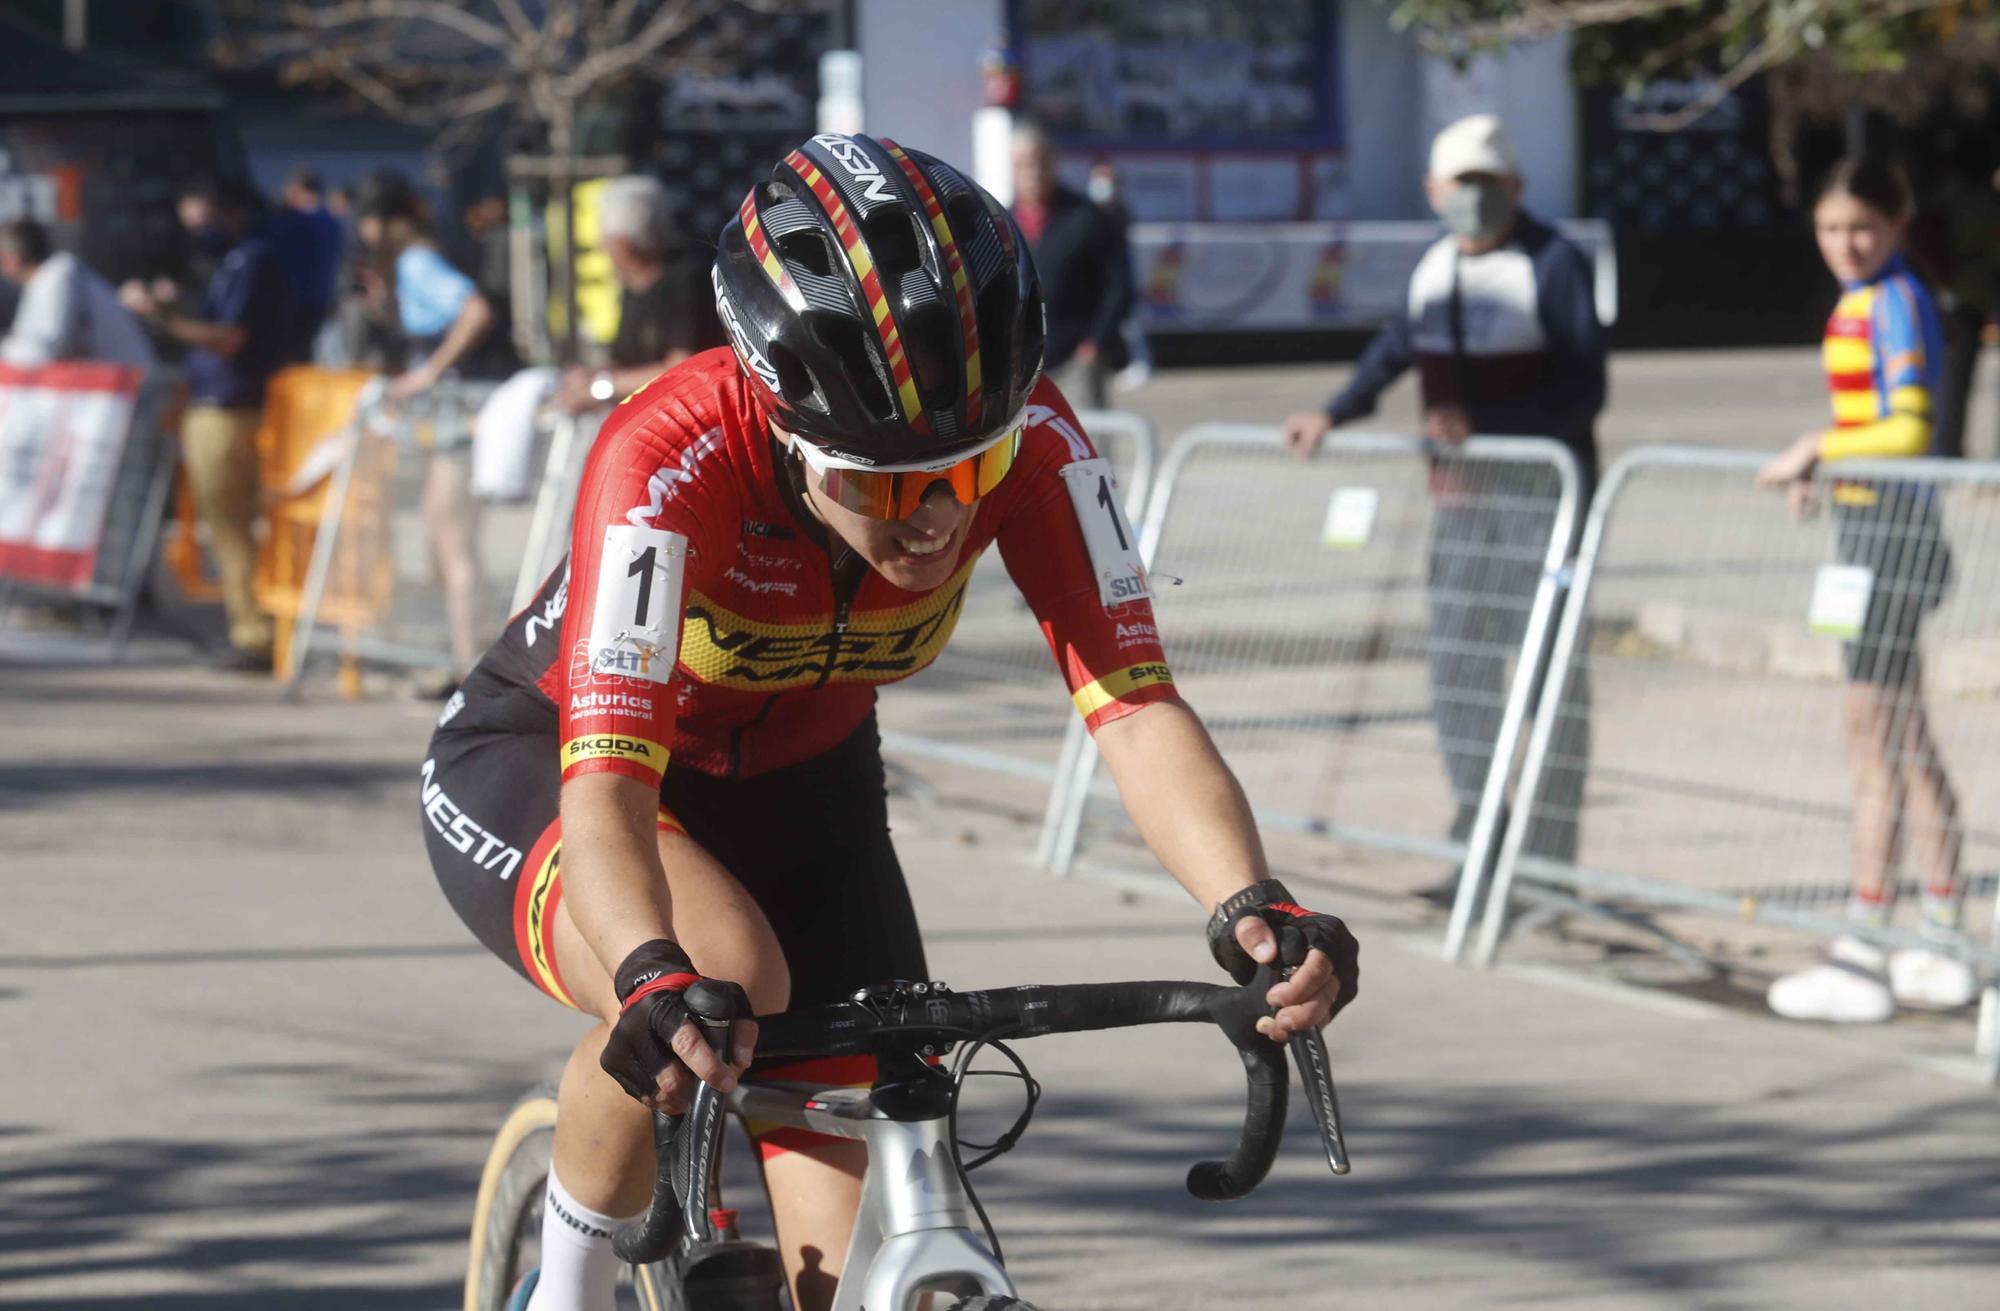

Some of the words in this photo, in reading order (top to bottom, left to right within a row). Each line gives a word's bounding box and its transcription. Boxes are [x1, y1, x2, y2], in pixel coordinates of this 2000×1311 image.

[830, 449, 875, 466] NESTA
[1097, 475, 1129, 551] 1
[627, 545, 657, 627] 1
[570, 691, 653, 710] Asturias
[609, 707, 653, 721] natural
[569, 738, 651, 757] ŠKODA
[421, 758, 523, 880] NESTA
[1306, 1038, 1339, 1142] ULTEGRA
[697, 1096, 718, 1209] ULTEGRA
